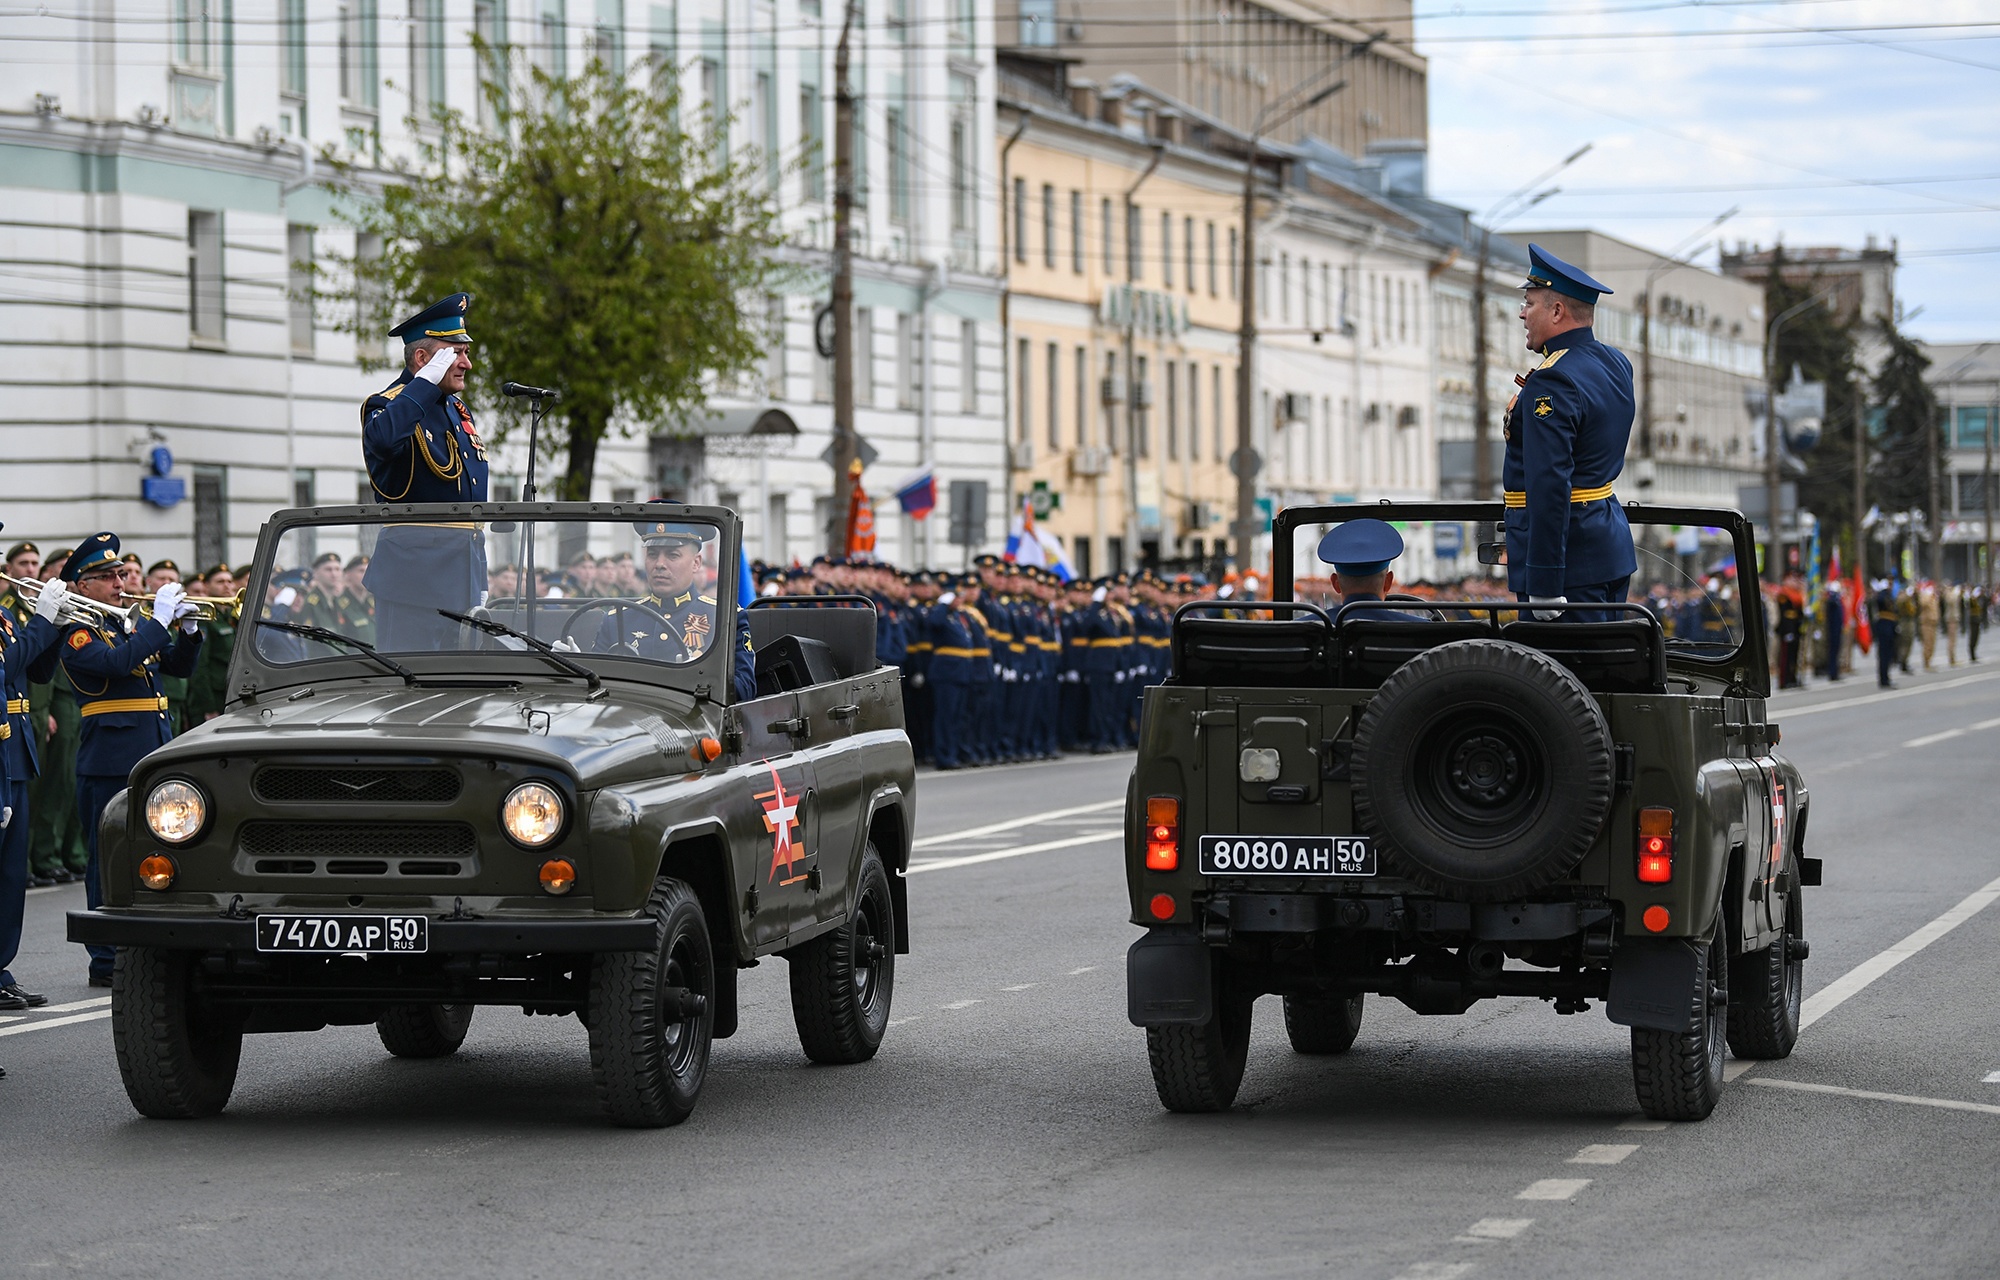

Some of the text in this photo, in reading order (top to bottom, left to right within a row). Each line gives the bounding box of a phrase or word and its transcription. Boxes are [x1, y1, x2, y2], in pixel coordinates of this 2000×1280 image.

[1213, 840, 1329, 870] 8080 АН
[1336, 840, 1366, 863] 50
[1340, 863, 1362, 872] RUS
[269, 919, 381, 948] 7470 АР
[390, 918, 418, 941] 50
[393, 941, 415, 950] RUS
